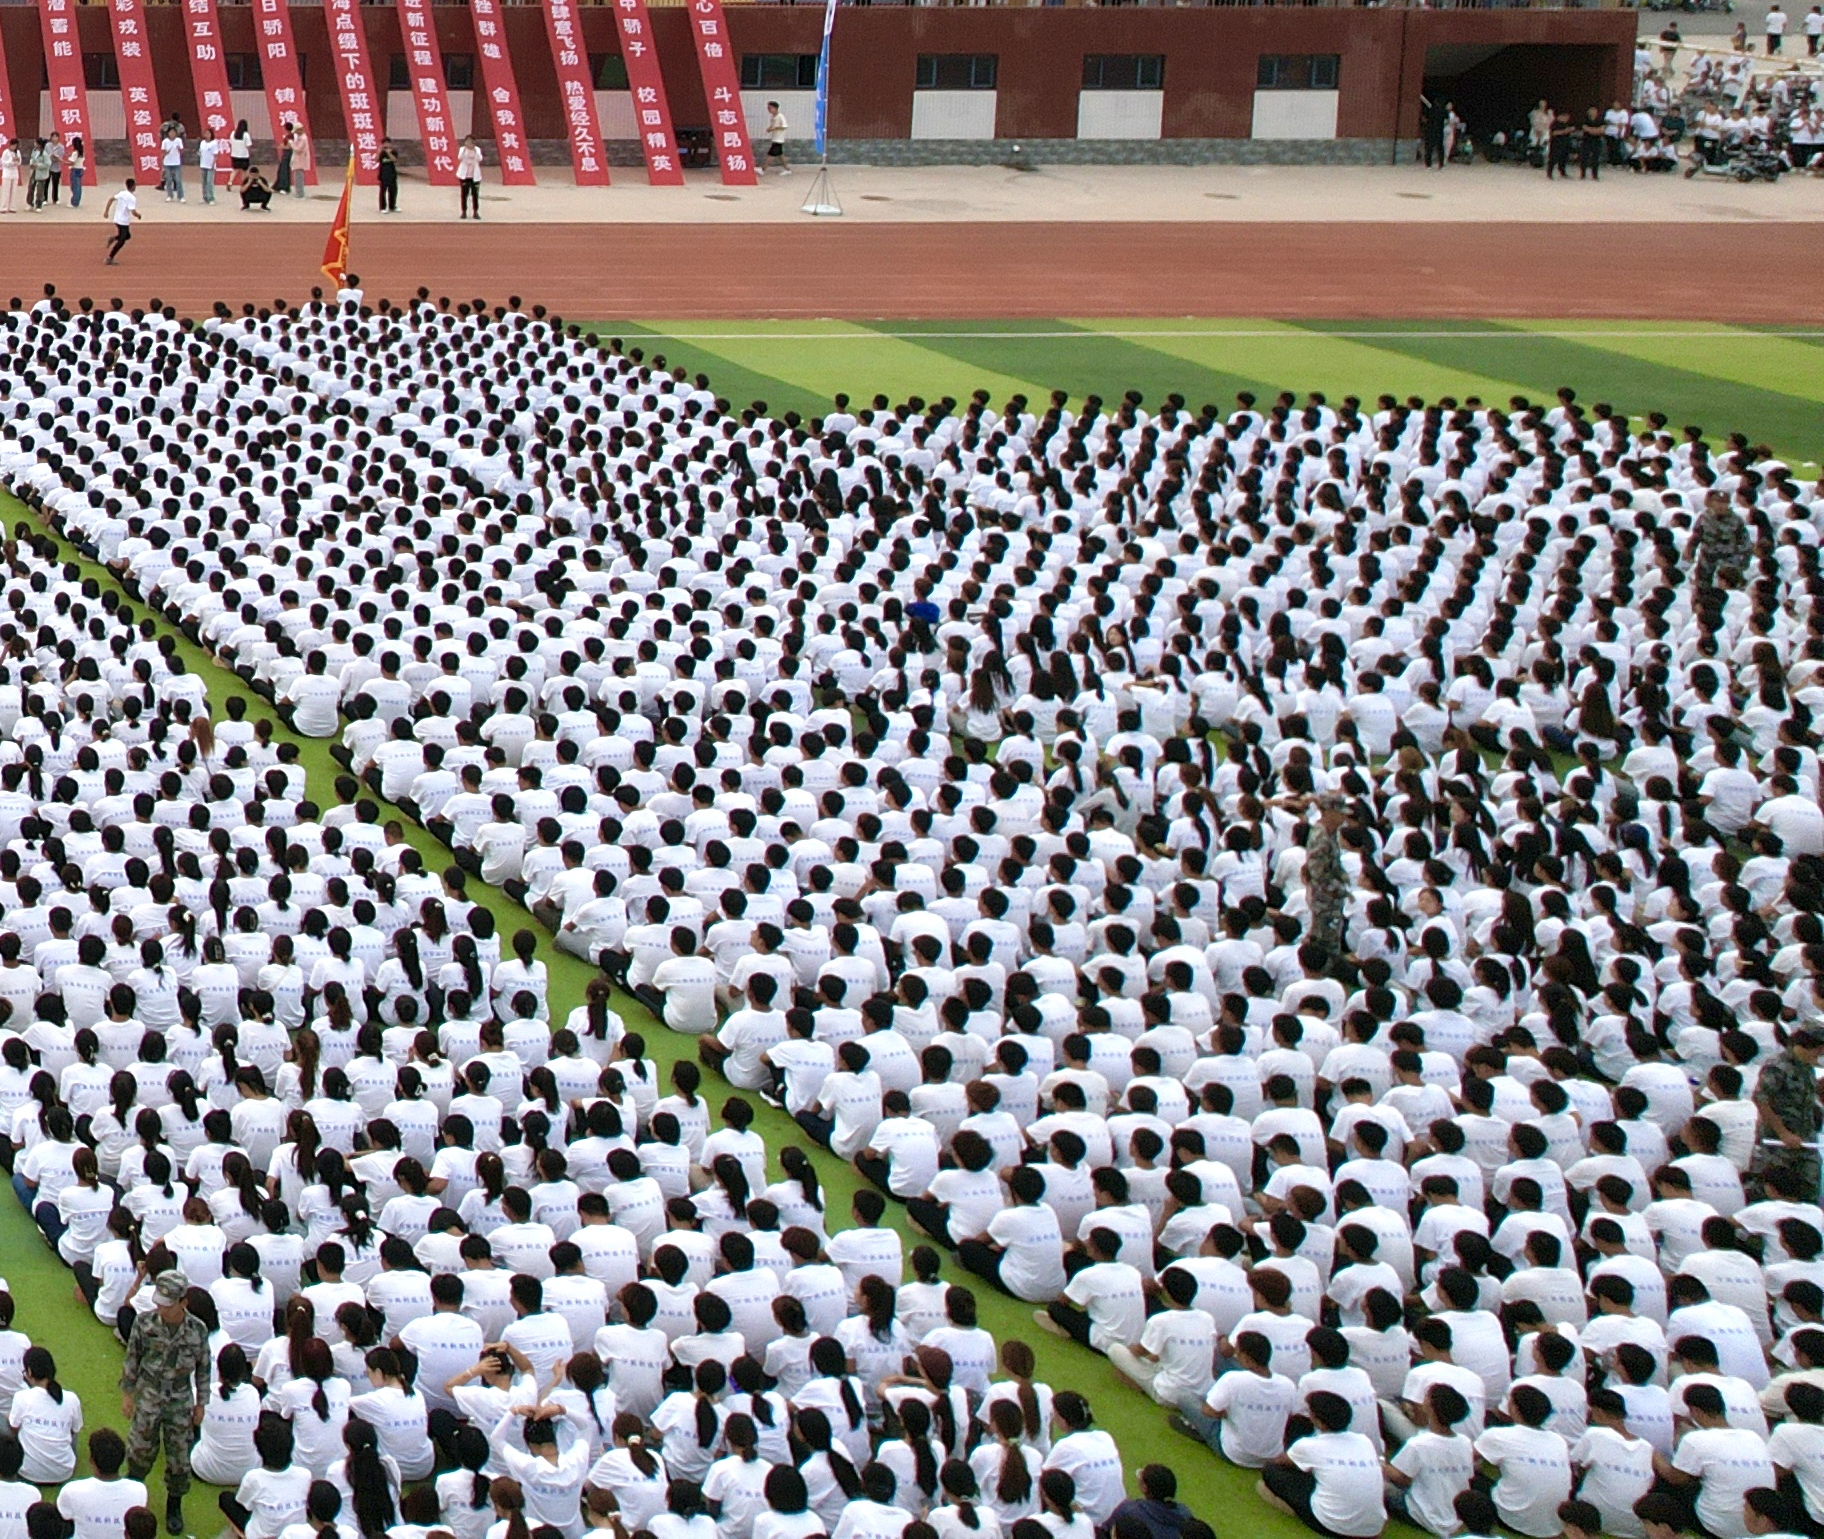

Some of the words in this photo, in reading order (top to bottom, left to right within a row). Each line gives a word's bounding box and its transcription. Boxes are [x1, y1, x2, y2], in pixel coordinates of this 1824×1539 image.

[129, 87, 160, 171] 英姿飒爽
[419, 78, 453, 171] 建功新时代
[493, 87, 525, 172] 舍我其谁
[565, 81, 599, 171] 热爱经久不息
[637, 87, 672, 171] 校园精英
[713, 86, 747, 171] 斗志昂扬
